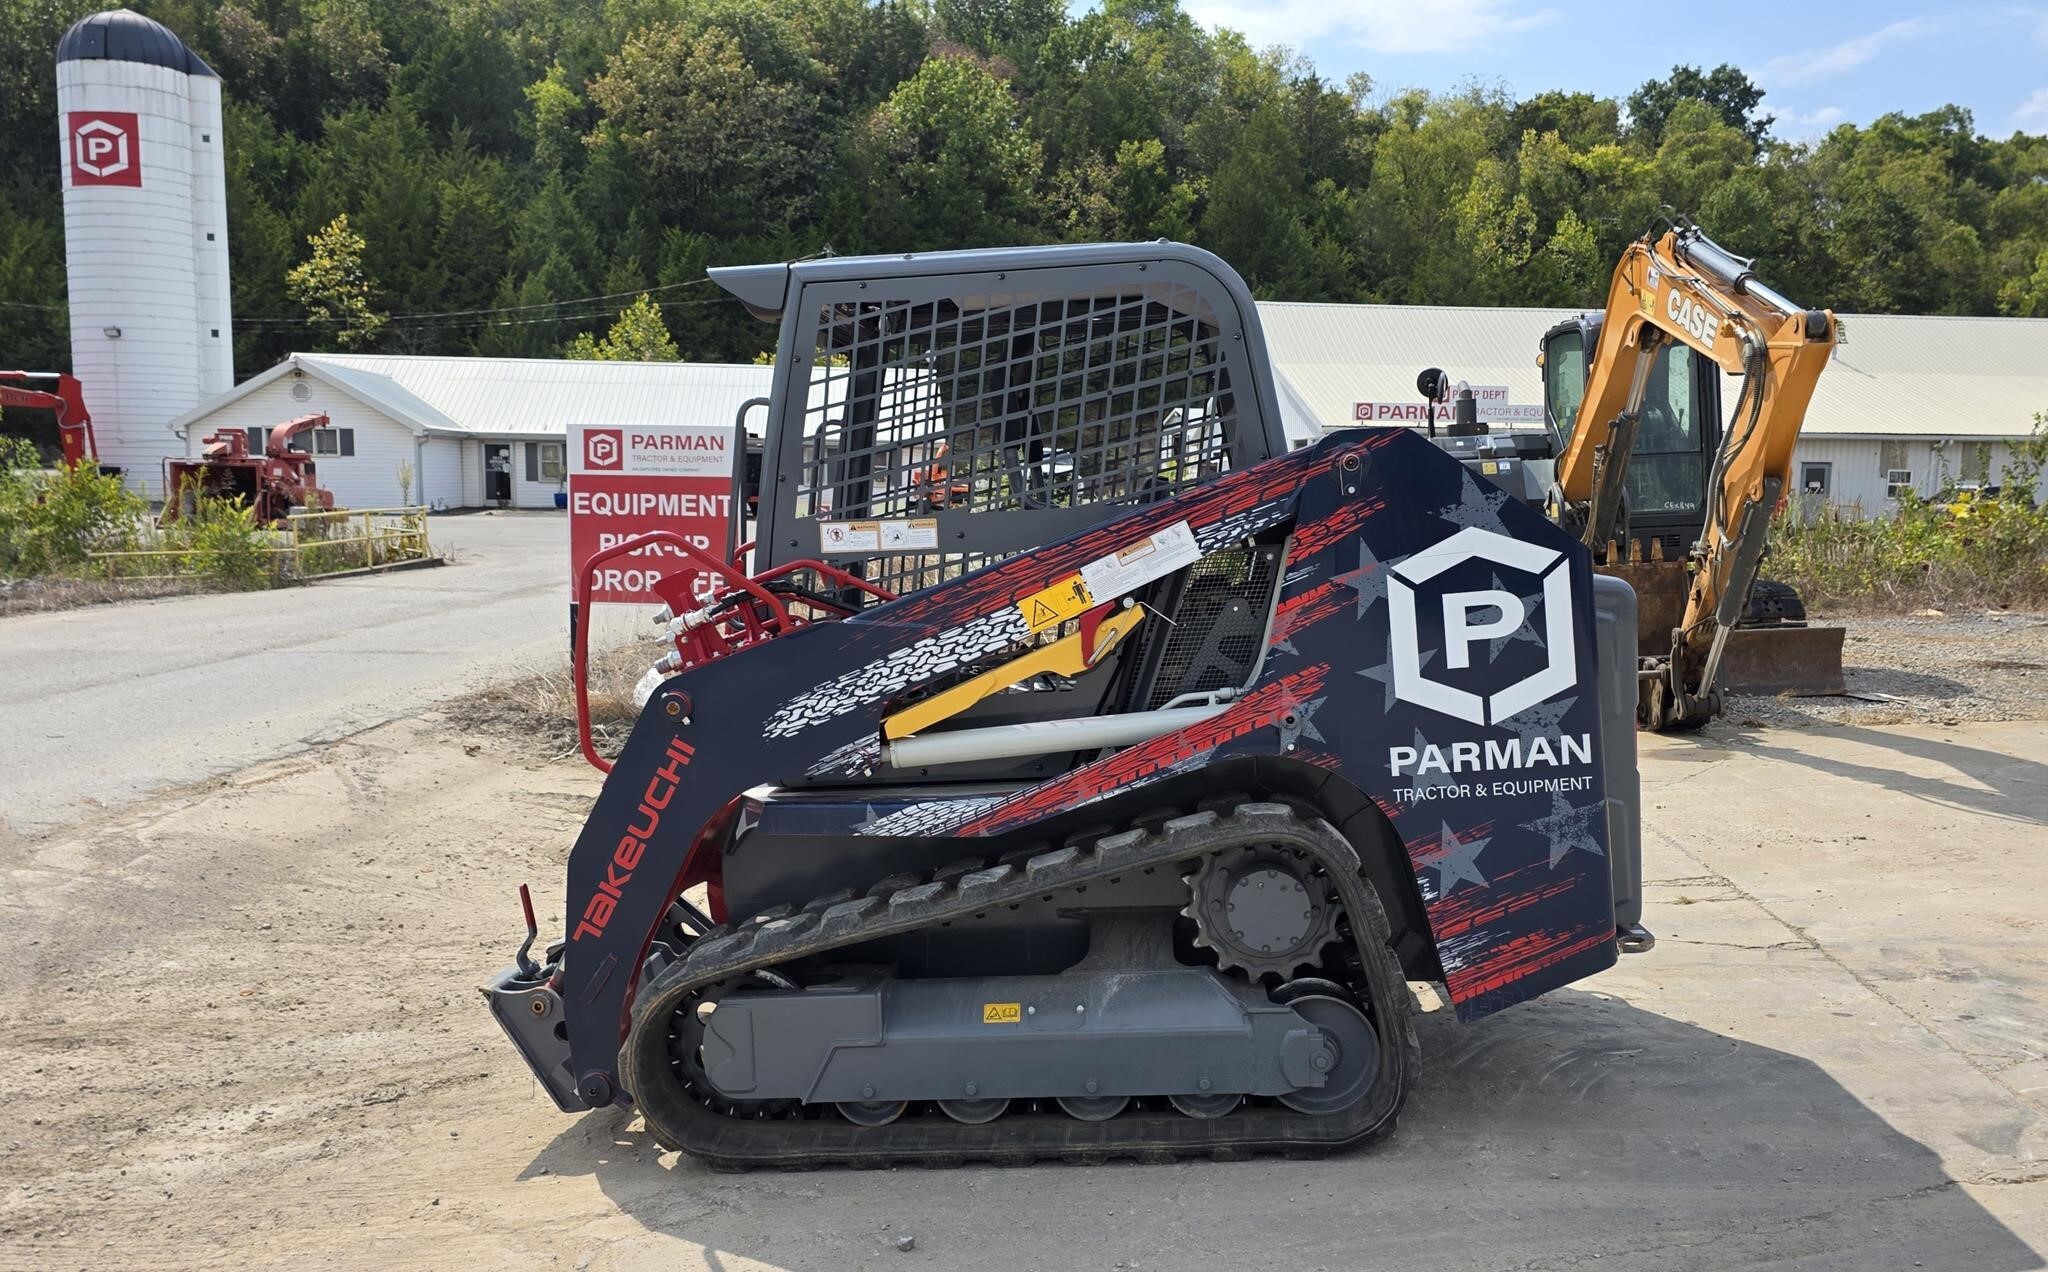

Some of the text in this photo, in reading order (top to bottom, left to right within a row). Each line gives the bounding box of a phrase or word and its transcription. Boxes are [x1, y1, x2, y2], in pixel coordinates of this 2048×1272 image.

[89, 137, 113, 161] P
[1667, 287, 1719, 350] CASE
[1482, 390, 1506, 399] DEPT
[1378, 405, 1457, 420] PARMA
[1513, 408, 1521, 416] &
[597, 444, 609, 457] P
[631, 434, 725, 451] PARMAN
[632, 454, 724, 464] TRACTOR & EQUIPMENT
[574, 492, 732, 517] EQUIPMENT
[1442, 589, 1525, 670] P
[1389, 733, 1592, 777] PARMAN
[1393, 776, 1593, 803] TRACTOR & EQUIPMENT
